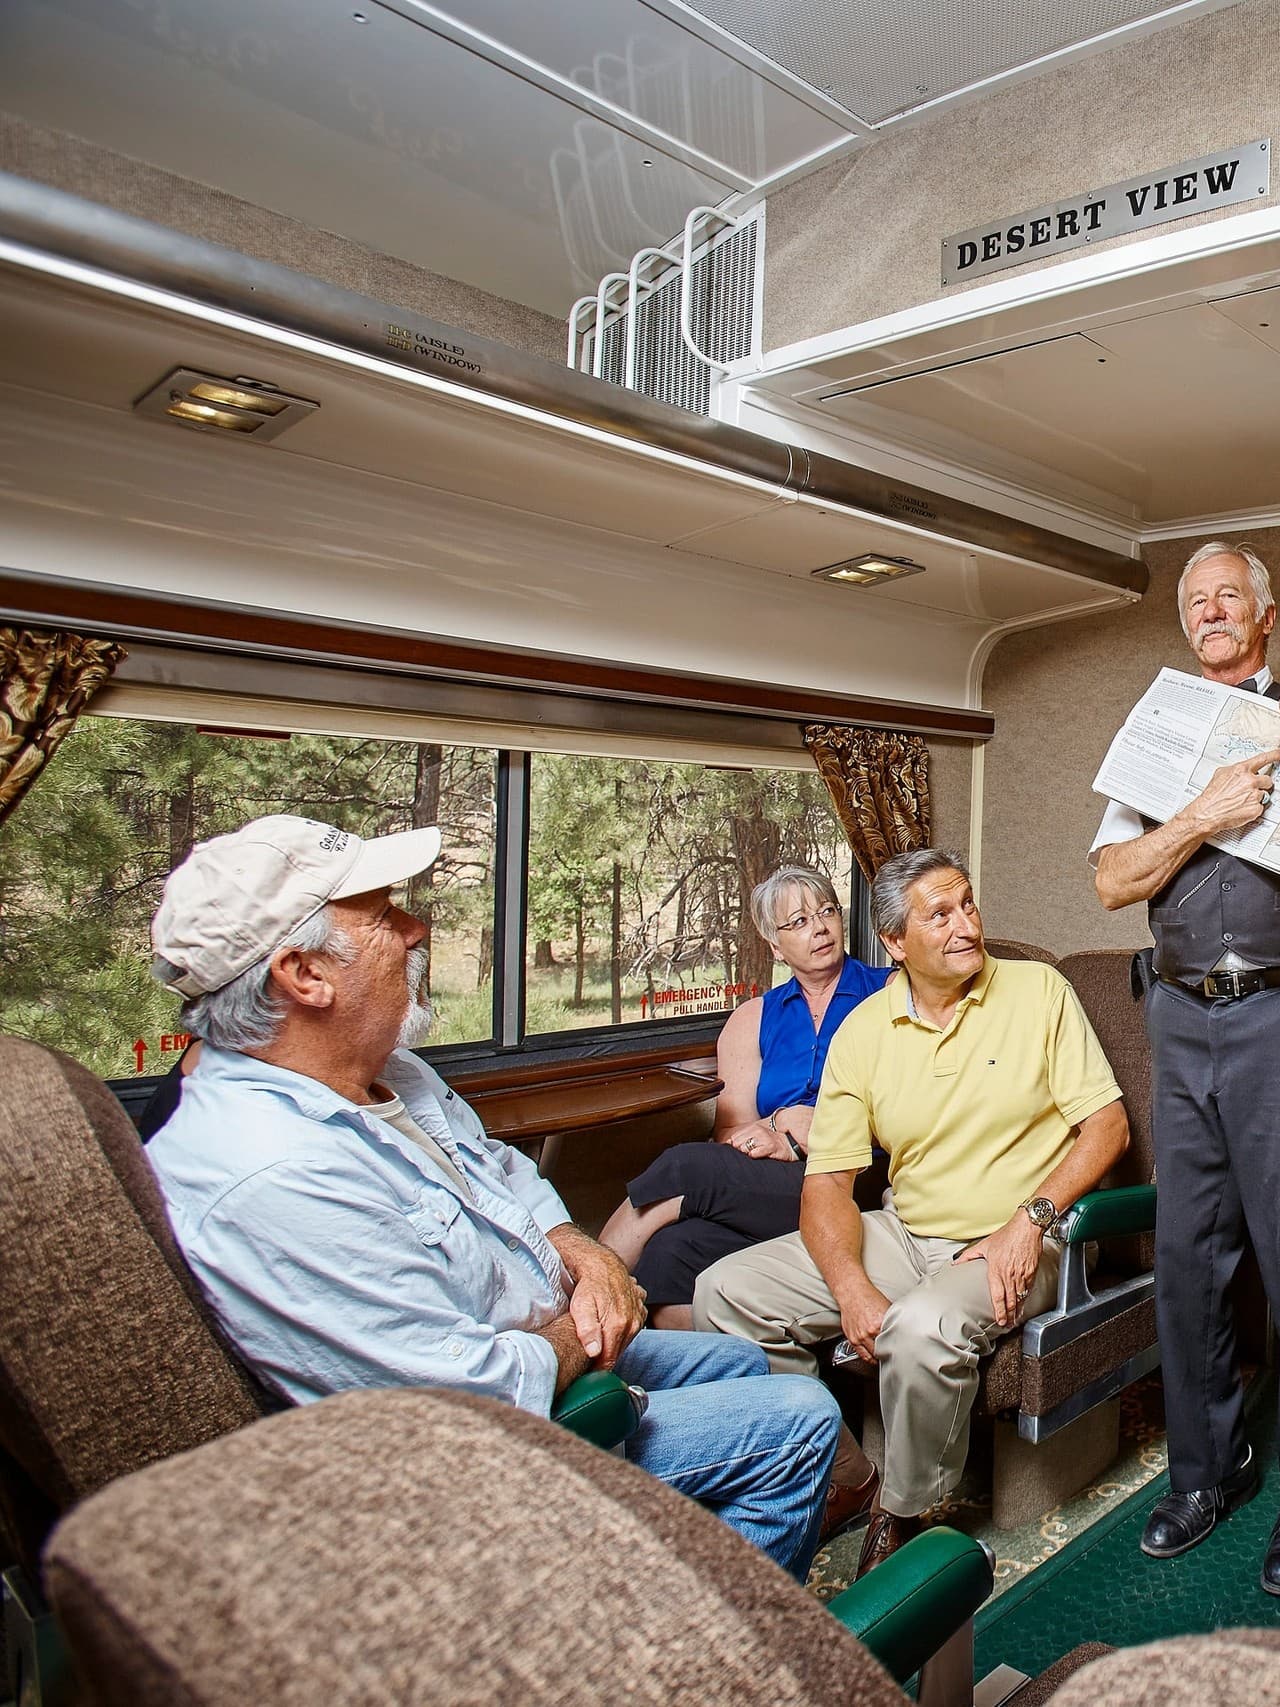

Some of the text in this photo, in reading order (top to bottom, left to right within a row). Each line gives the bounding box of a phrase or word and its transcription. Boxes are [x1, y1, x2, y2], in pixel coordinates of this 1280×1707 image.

[957, 160, 1240, 270] DESERT VIEW
[415, 333, 465, 357] (AISLE)
[414, 345, 481, 374] (WINDOW)
[319, 827, 339, 850] GRAN
[654, 983, 746, 1004] EMERGENCY EXIT
[673, 1001, 729, 1016] PULL HANDLE
